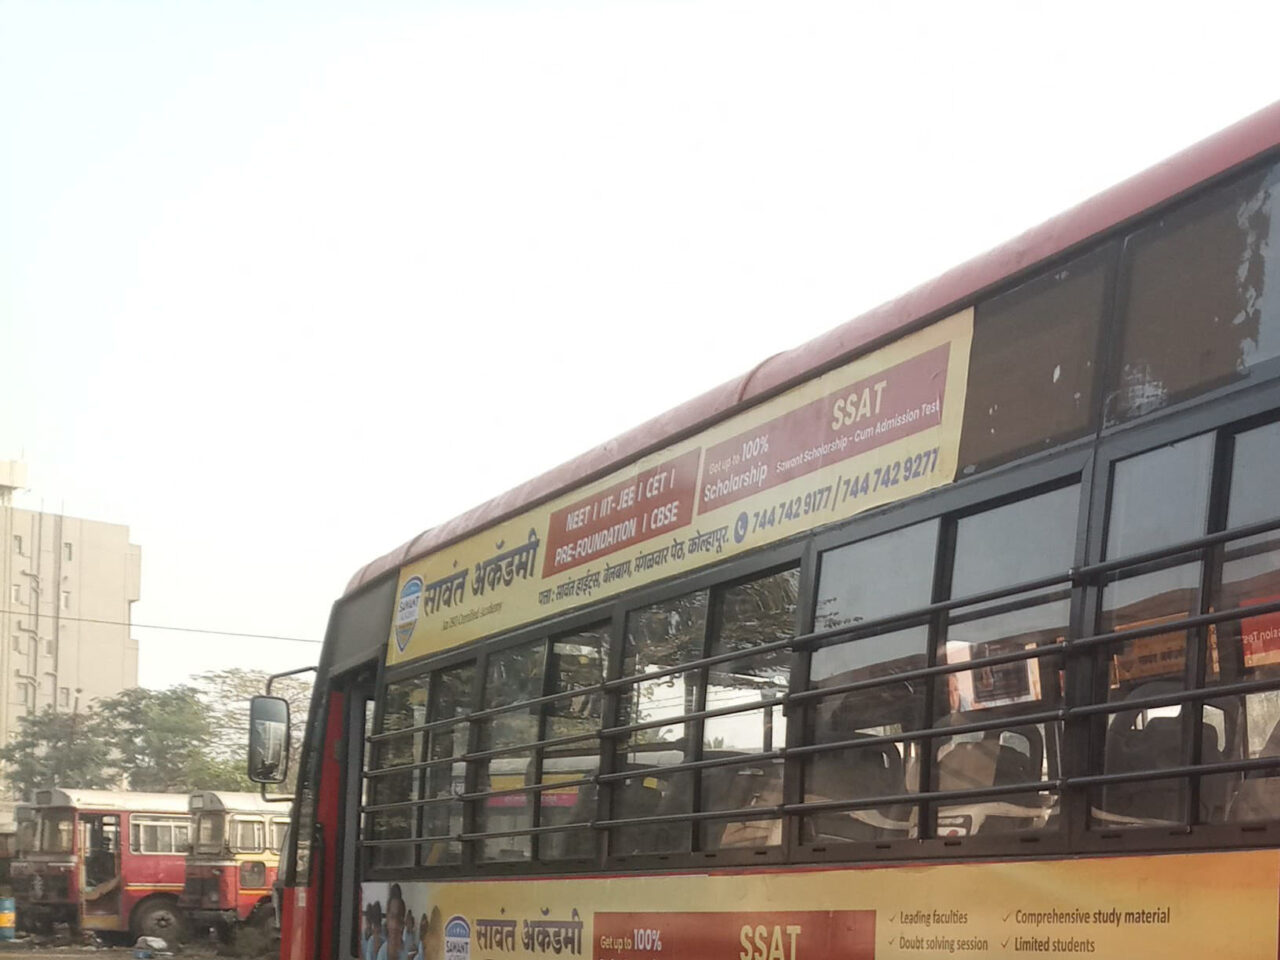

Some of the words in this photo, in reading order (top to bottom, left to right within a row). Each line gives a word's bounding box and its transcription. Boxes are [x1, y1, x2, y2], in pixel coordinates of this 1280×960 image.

[831, 380, 888, 431] SSAT
[709, 461, 721, 475] Get
[721, 457, 731, 472] up
[732, 454, 741, 465] to
[741, 434, 769, 459] 100%
[776, 454, 803, 473] Sawant
[803, 438, 848, 463] Scholarship
[854, 428, 874, 442] Cum
[875, 408, 920, 435] Admission
[921, 398, 940, 417] Test
[566, 505, 591, 532] NEET
[646, 472, 667, 498] CET
[703, 463, 768, 503] Scholarship
[752, 504, 776, 533] 744
[778, 495, 801, 525] 742
[803, 484, 832, 515] 9177
[842, 475, 870, 503] 744
[873, 461, 900, 490] 742
[903, 447, 940, 482] 9277
[554, 518, 637, 567] PRE-FOUNDATION
[651, 501, 679, 530] CBSE
[424, 560, 469, 617] सावंत
[476, 907, 517, 953] सावंत
[521, 907, 583, 956] अकॅडमी
[900, 911, 931, 927] Leading
[932, 909, 968, 925] faculties
[1015, 909, 1090, 927] Comprehensive
[1092, 908, 1122, 927] study
[1124, 907, 1171, 924] material
[600, 935, 613, 949] Get
[614, 938, 623, 952] up
[624, 936, 632, 949] to
[633, 929, 662, 951] 100%
[899, 936, 924, 950] Doubt
[926, 937, 955, 954] solving
[956, 938, 988, 951] session
[1014, 937, 1049, 952] Limited
[1052, 938, 1095, 953] students
